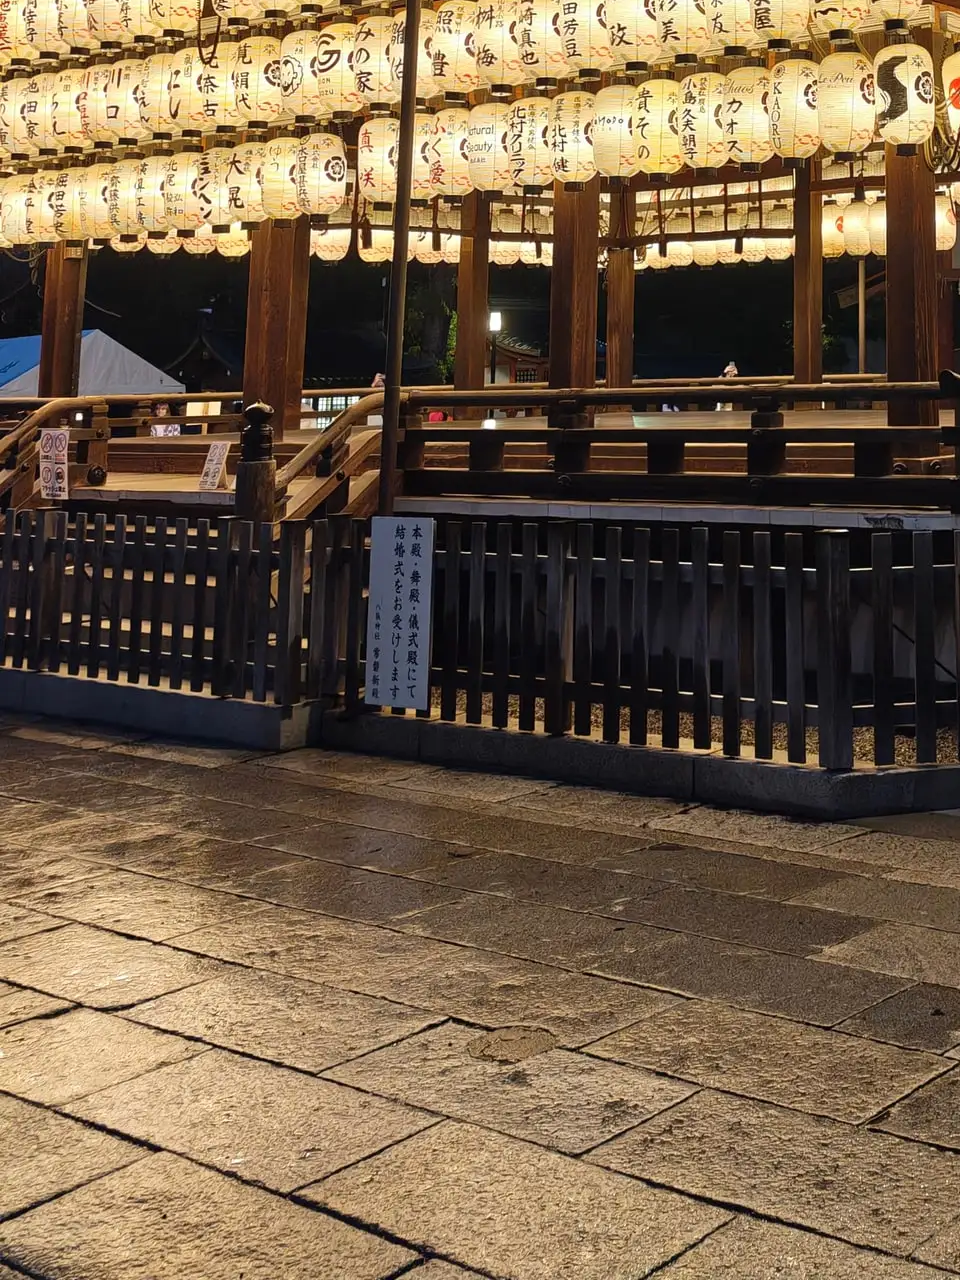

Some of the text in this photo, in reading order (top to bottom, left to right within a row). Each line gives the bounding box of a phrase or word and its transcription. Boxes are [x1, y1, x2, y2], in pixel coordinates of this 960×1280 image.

[355, 21, 375, 94] みの家
[429, 116, 447, 186] ふく愛
[509, 106, 529, 180] 北村クリニック
[635, 87, 654, 160] 貴その
[727, 97, 744, 153] カオス
[770, 81, 783, 150] KAORU
[390, 524, 407, 700] 結婚式をお受けします
[406, 524, 424, 699] 本殿・舞殿・儀式殿にて
